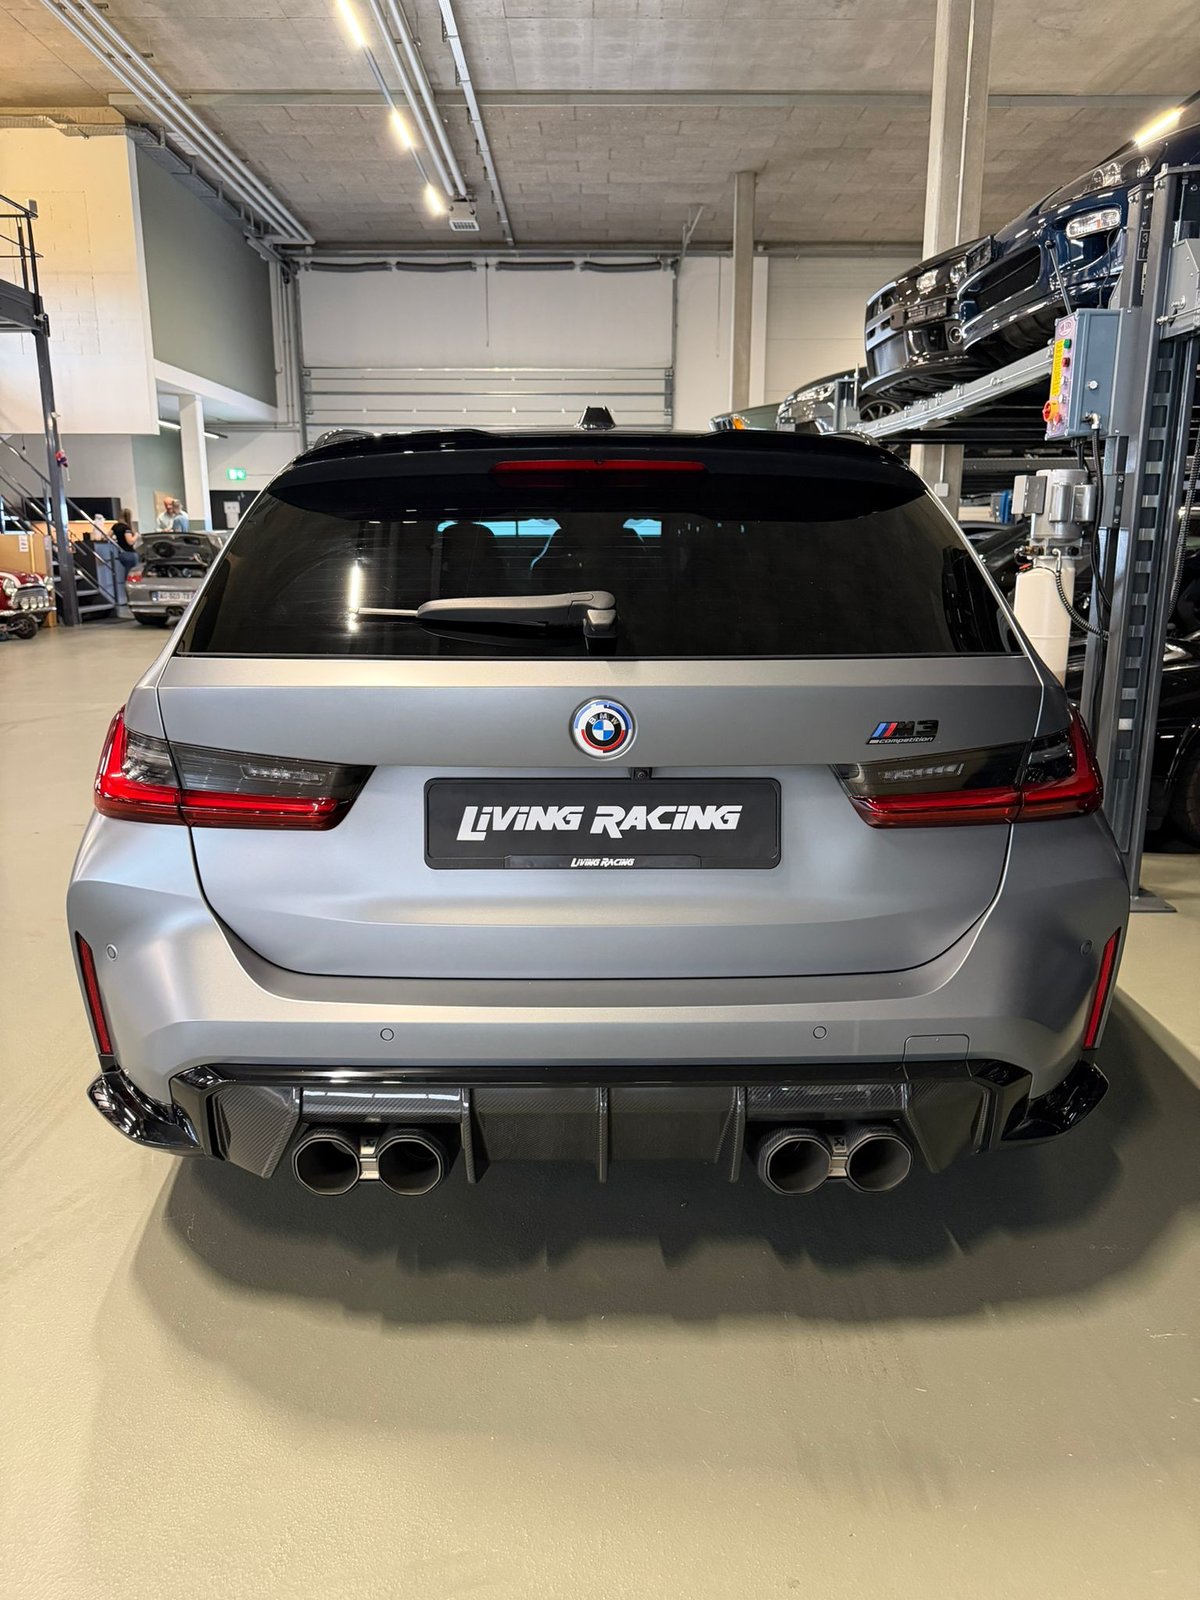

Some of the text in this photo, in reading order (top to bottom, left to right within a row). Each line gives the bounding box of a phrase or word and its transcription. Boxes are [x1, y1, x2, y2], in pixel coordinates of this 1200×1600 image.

[589, 713, 619, 725] BMW
[892, 719, 939, 737] M3
[879, 736, 934, 745] competition
